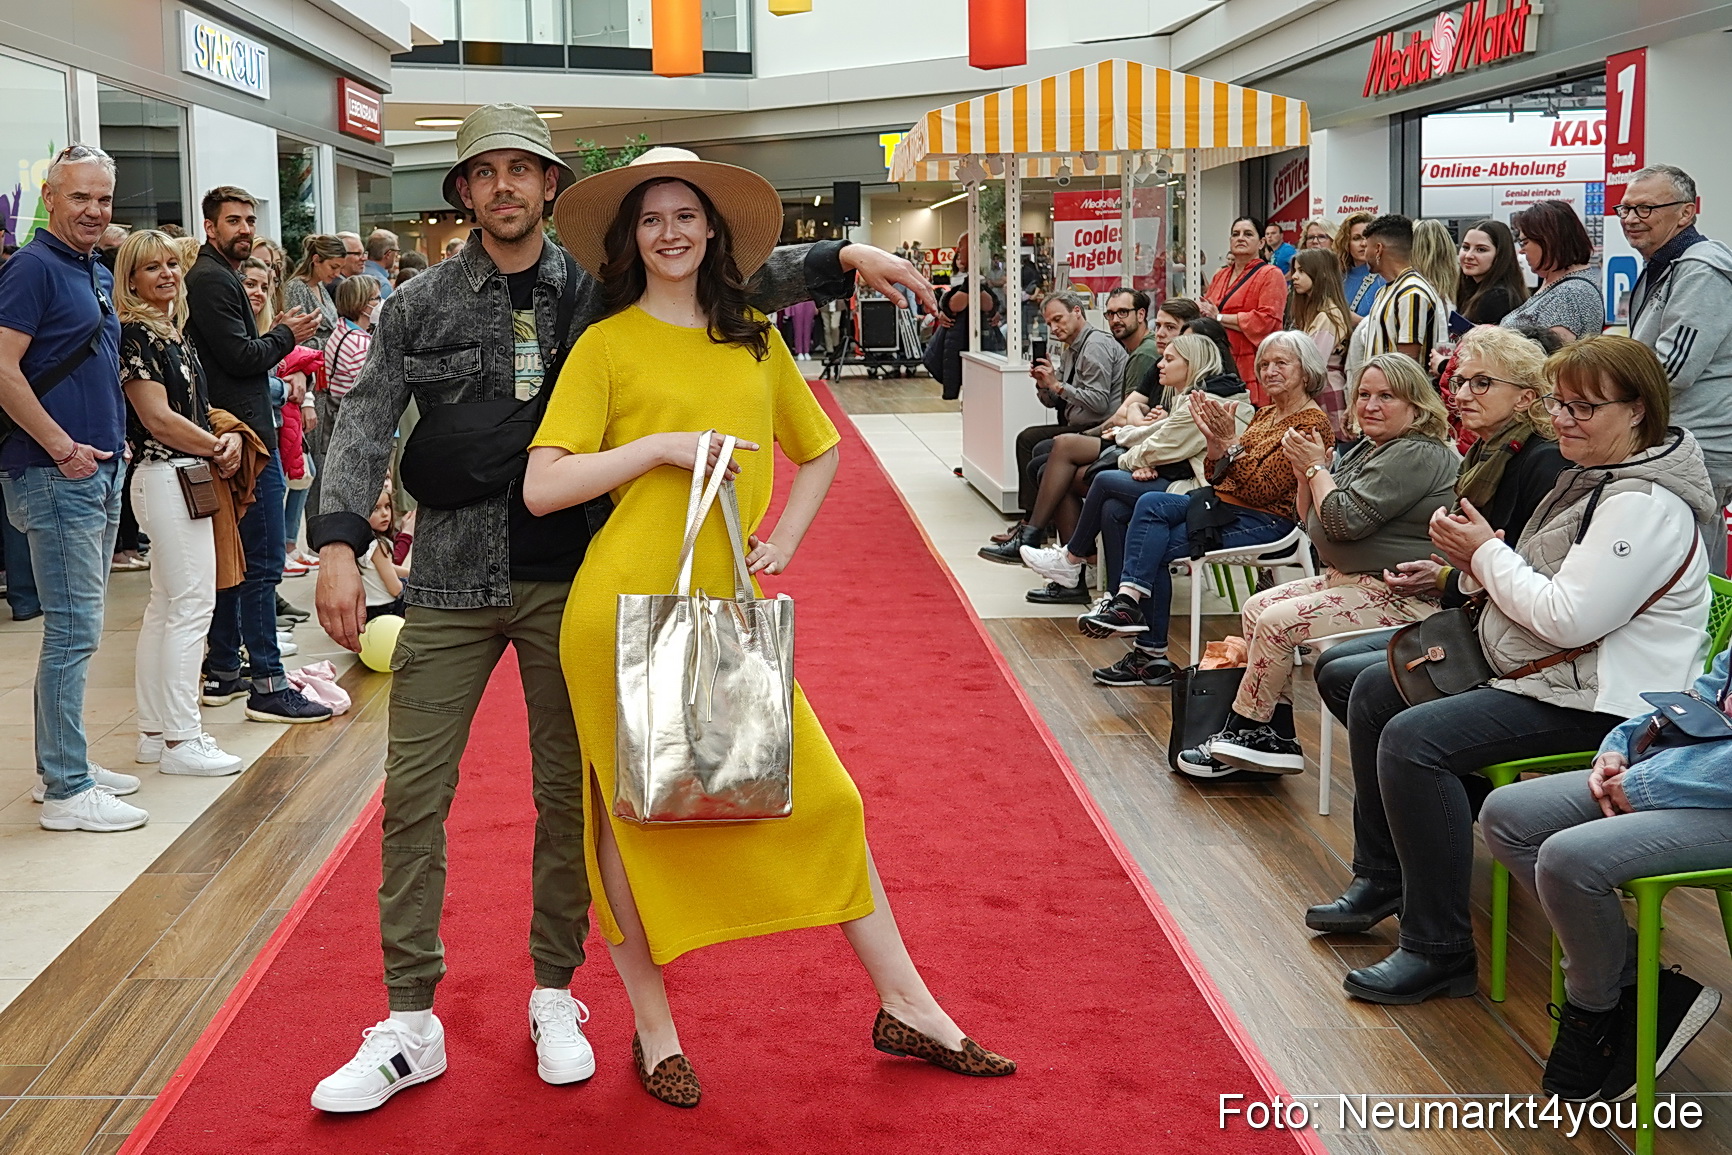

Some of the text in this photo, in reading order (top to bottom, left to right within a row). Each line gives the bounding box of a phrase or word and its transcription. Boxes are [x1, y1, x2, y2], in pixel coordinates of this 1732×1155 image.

[194, 23, 266, 89] STARCUT
[349, 98, 379, 124] LEBENSRAUM
[1617, 63, 1637, 144] 1
[1550, 119, 1607, 147] KAS
[1430, 160, 1567, 178] Online-Abholung
[1273, 157, 1309, 211] Service
[1505, 188, 1561, 198] Genial einfach
[1342, 195, 1374, 204] Online-
